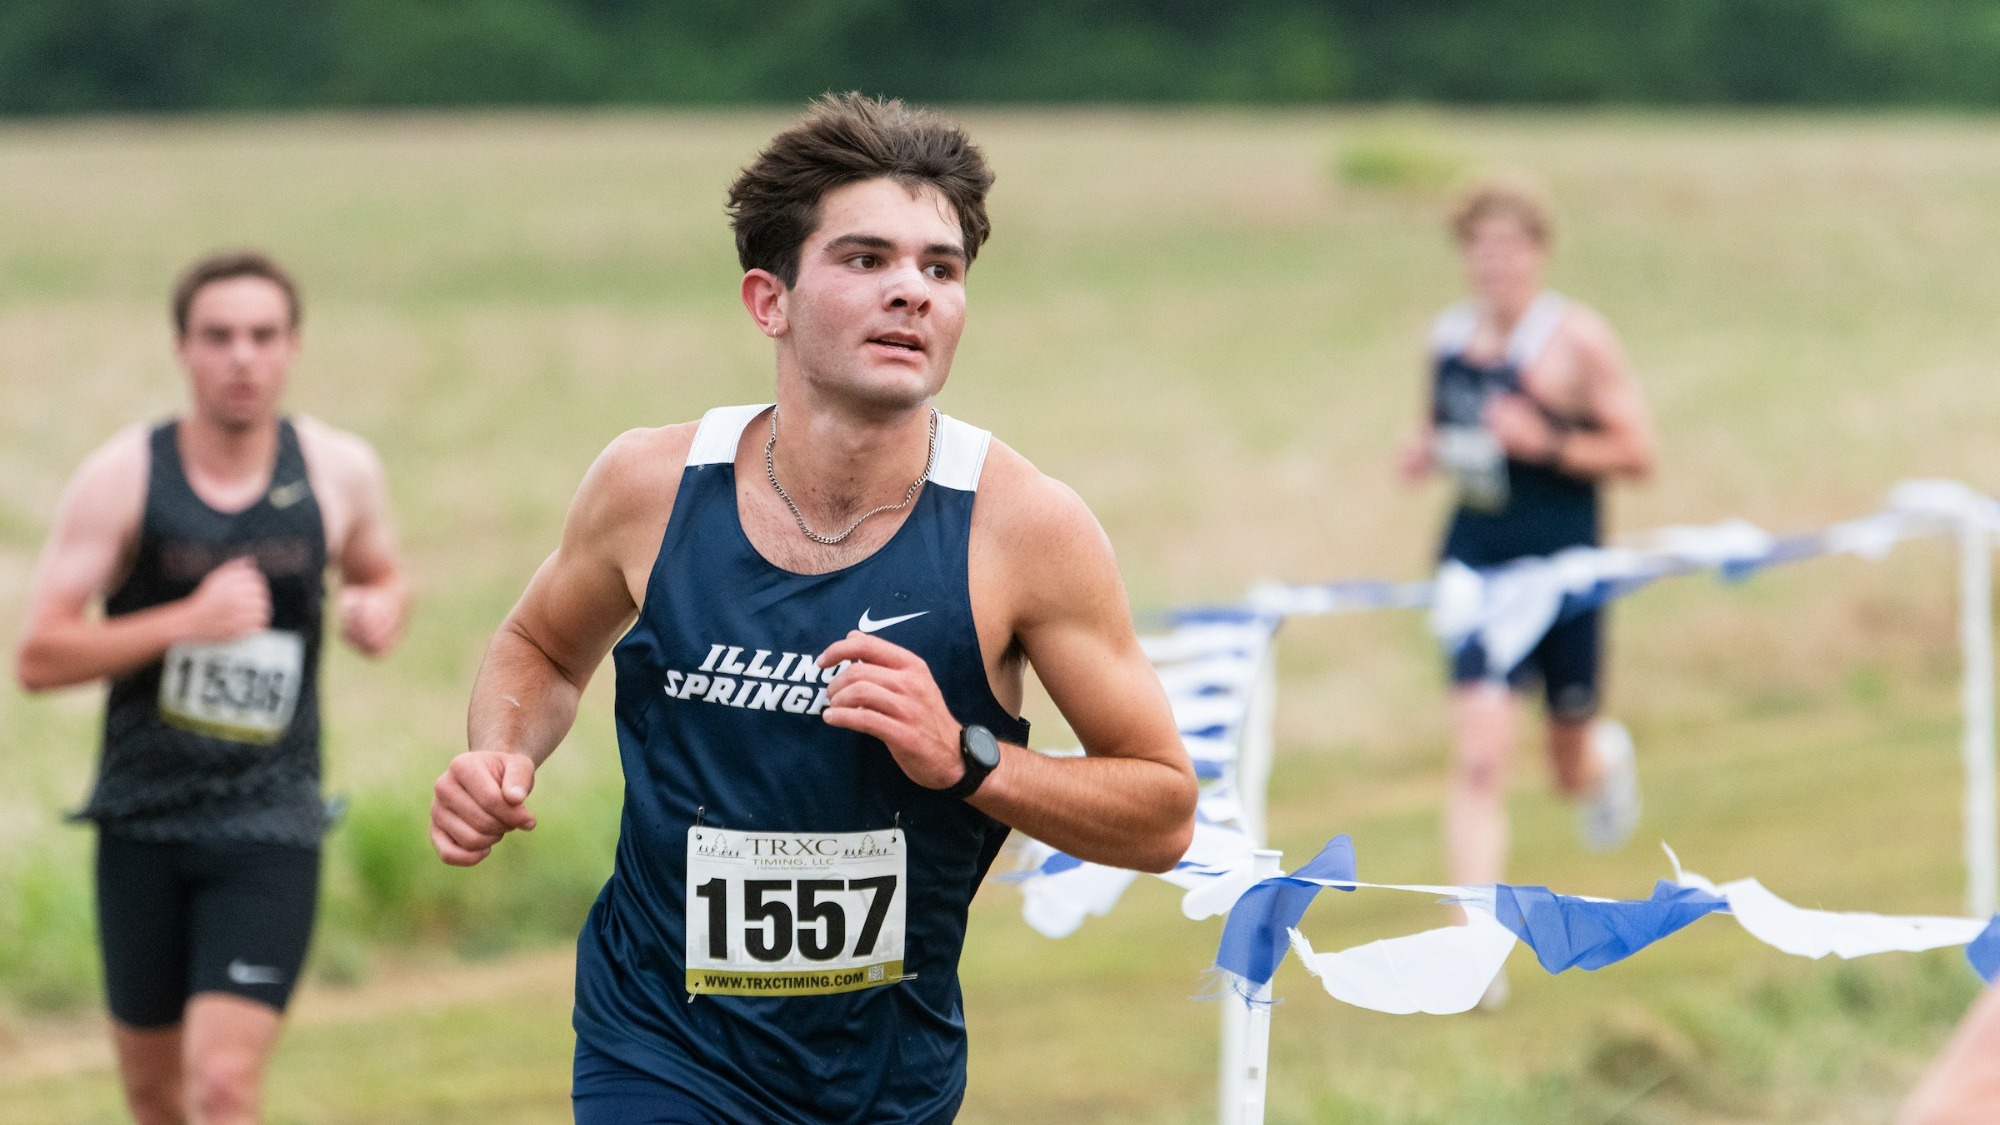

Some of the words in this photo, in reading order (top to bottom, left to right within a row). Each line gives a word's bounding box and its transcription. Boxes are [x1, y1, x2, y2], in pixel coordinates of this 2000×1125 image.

[698, 643, 861, 685] ILLINO
[663, 669, 831, 715] SPRINGF
[745, 838, 838, 856] TRXC
[753, 858, 807, 867] TIMING,
[812, 858, 834, 866] LLC
[696, 874, 897, 963] 1557
[704, 972, 864, 990] WWW.TRXCTIMING.COM
